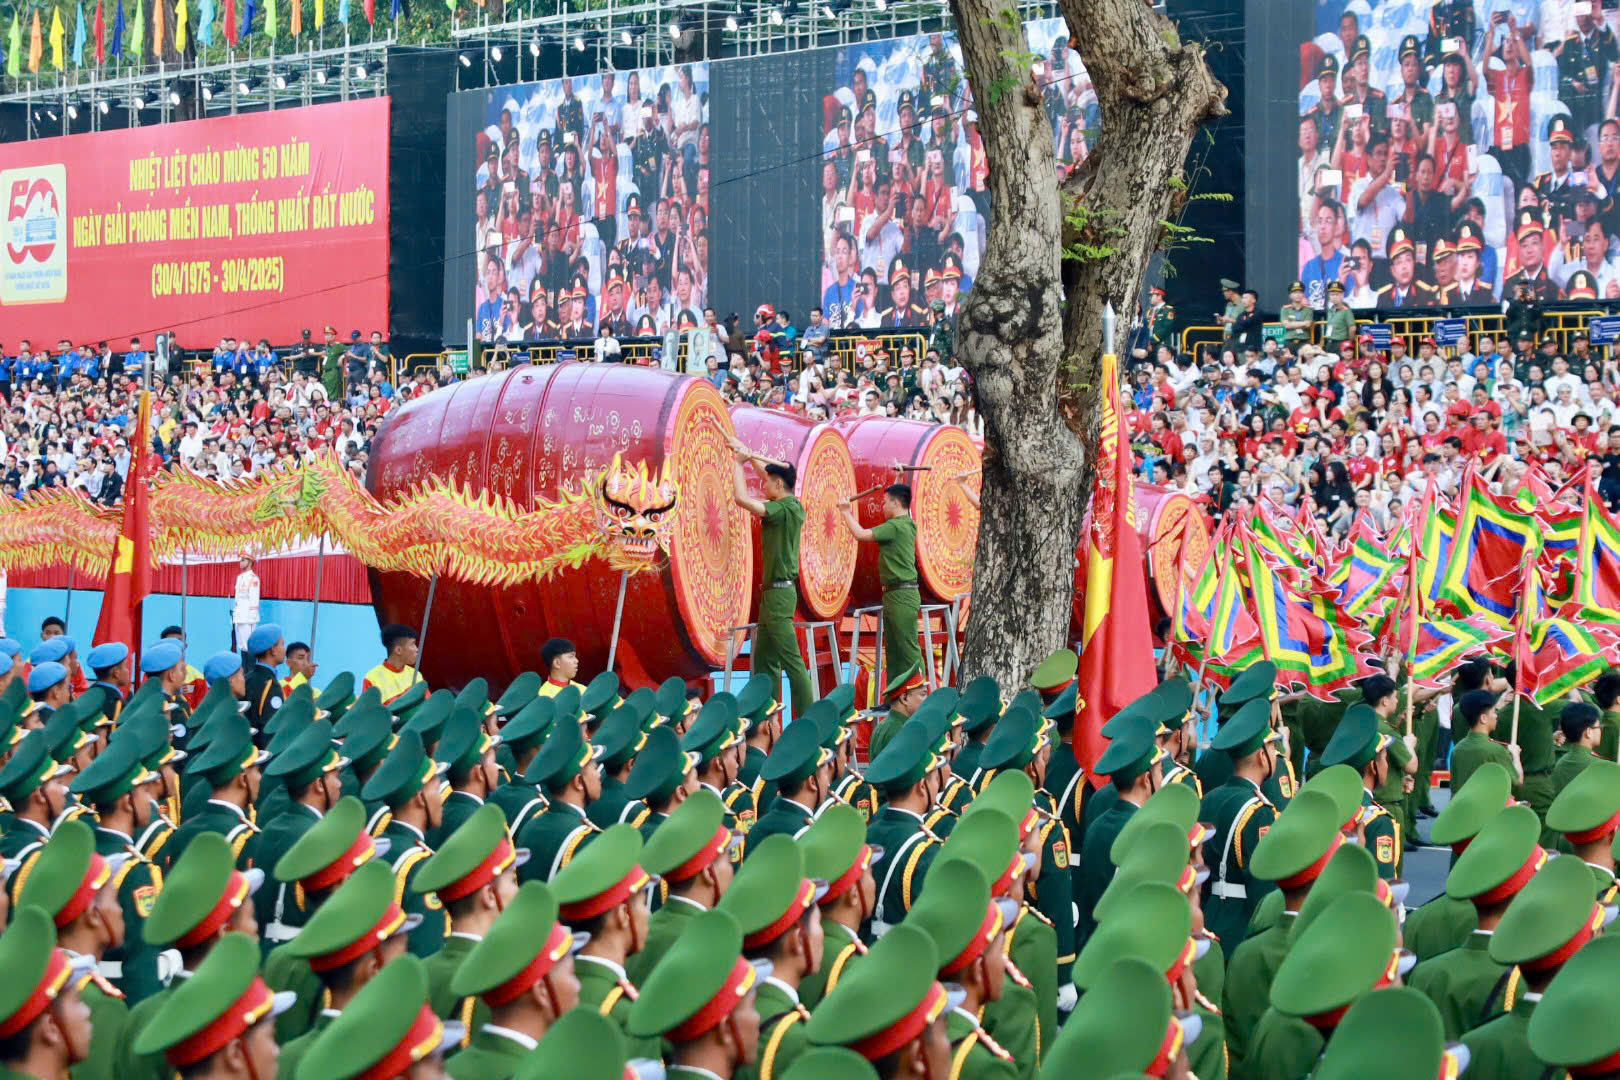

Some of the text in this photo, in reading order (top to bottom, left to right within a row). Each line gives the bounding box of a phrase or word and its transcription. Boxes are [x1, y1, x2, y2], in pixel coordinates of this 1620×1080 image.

[130, 135, 310, 197] NHIỆT LIỆT CHÀO MỪNG 50 NĂM
[73, 181, 375, 248] NGÀY GIẢI PHÓNG MIỀN NAM, THỐNG NHẤT ĐẤT NƯỚC
[152, 261, 211, 299] (30/4/1975
[222, 256, 284, 293] 30/4/2025)
